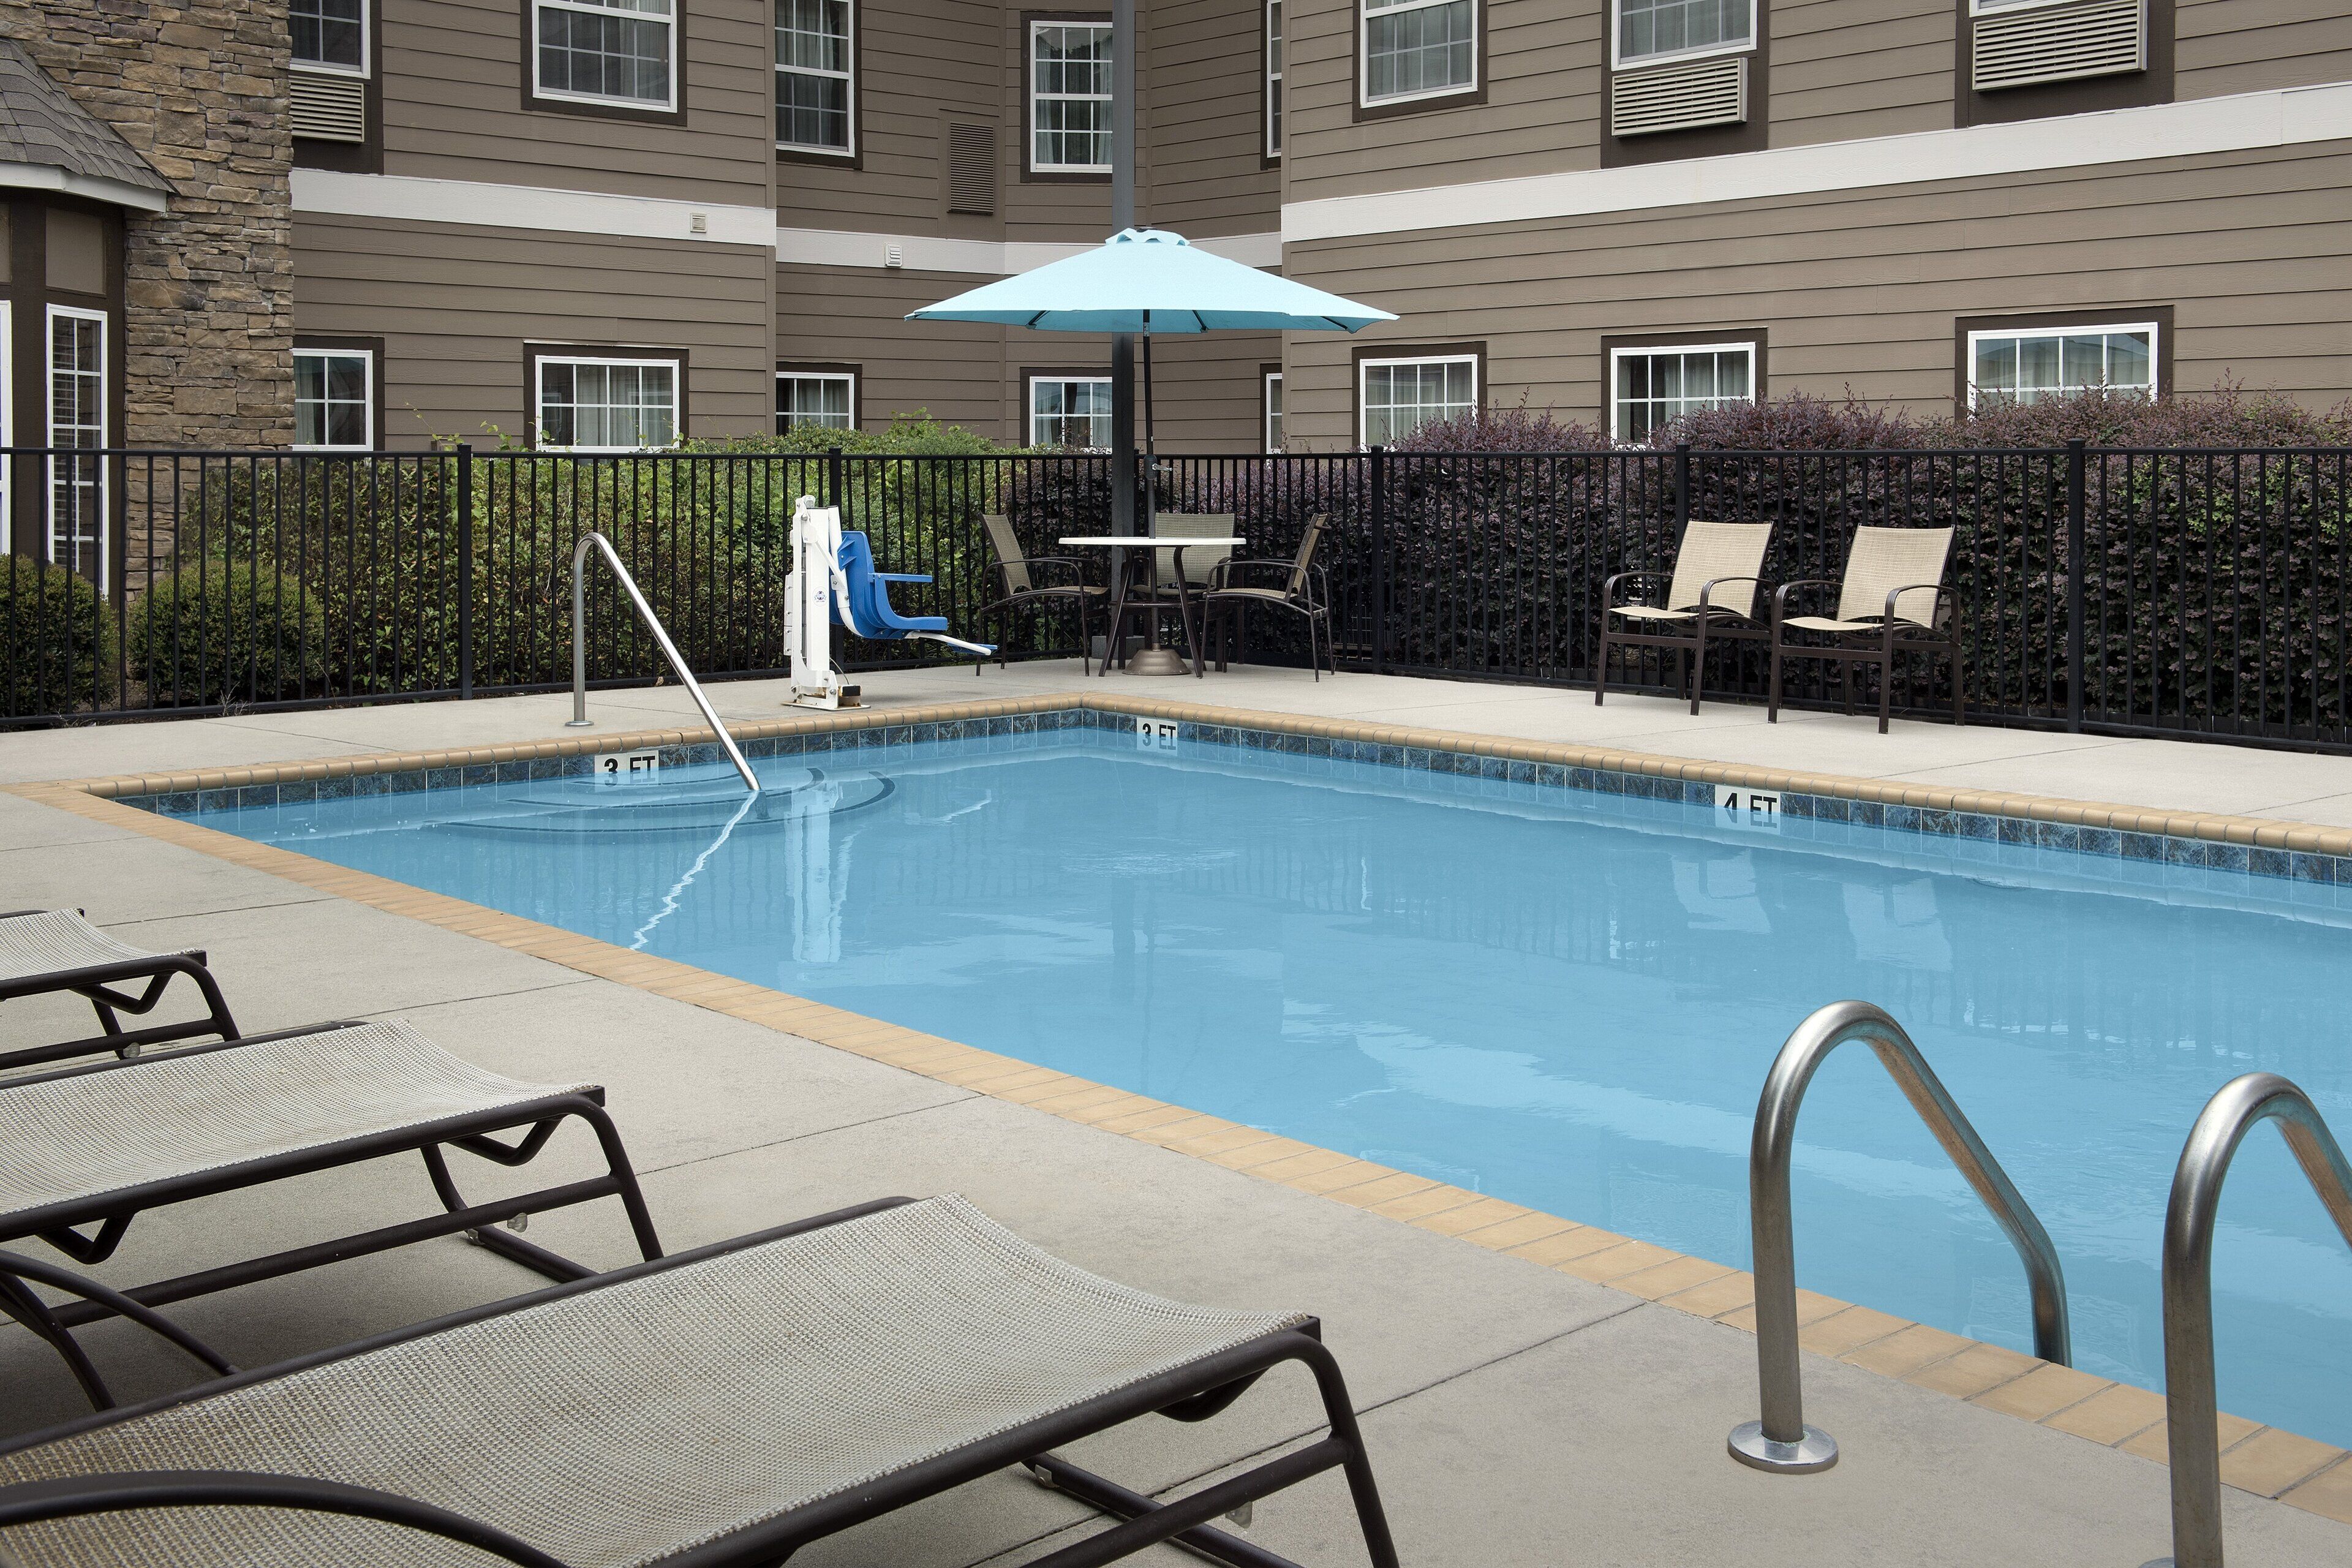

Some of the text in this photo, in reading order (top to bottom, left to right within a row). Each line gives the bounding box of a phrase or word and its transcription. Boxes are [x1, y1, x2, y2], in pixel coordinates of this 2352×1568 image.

[1142, 723, 1176, 739] 3 FT
[604, 755, 655, 774] 3 FT
[1750, 794, 1777, 815] FT
